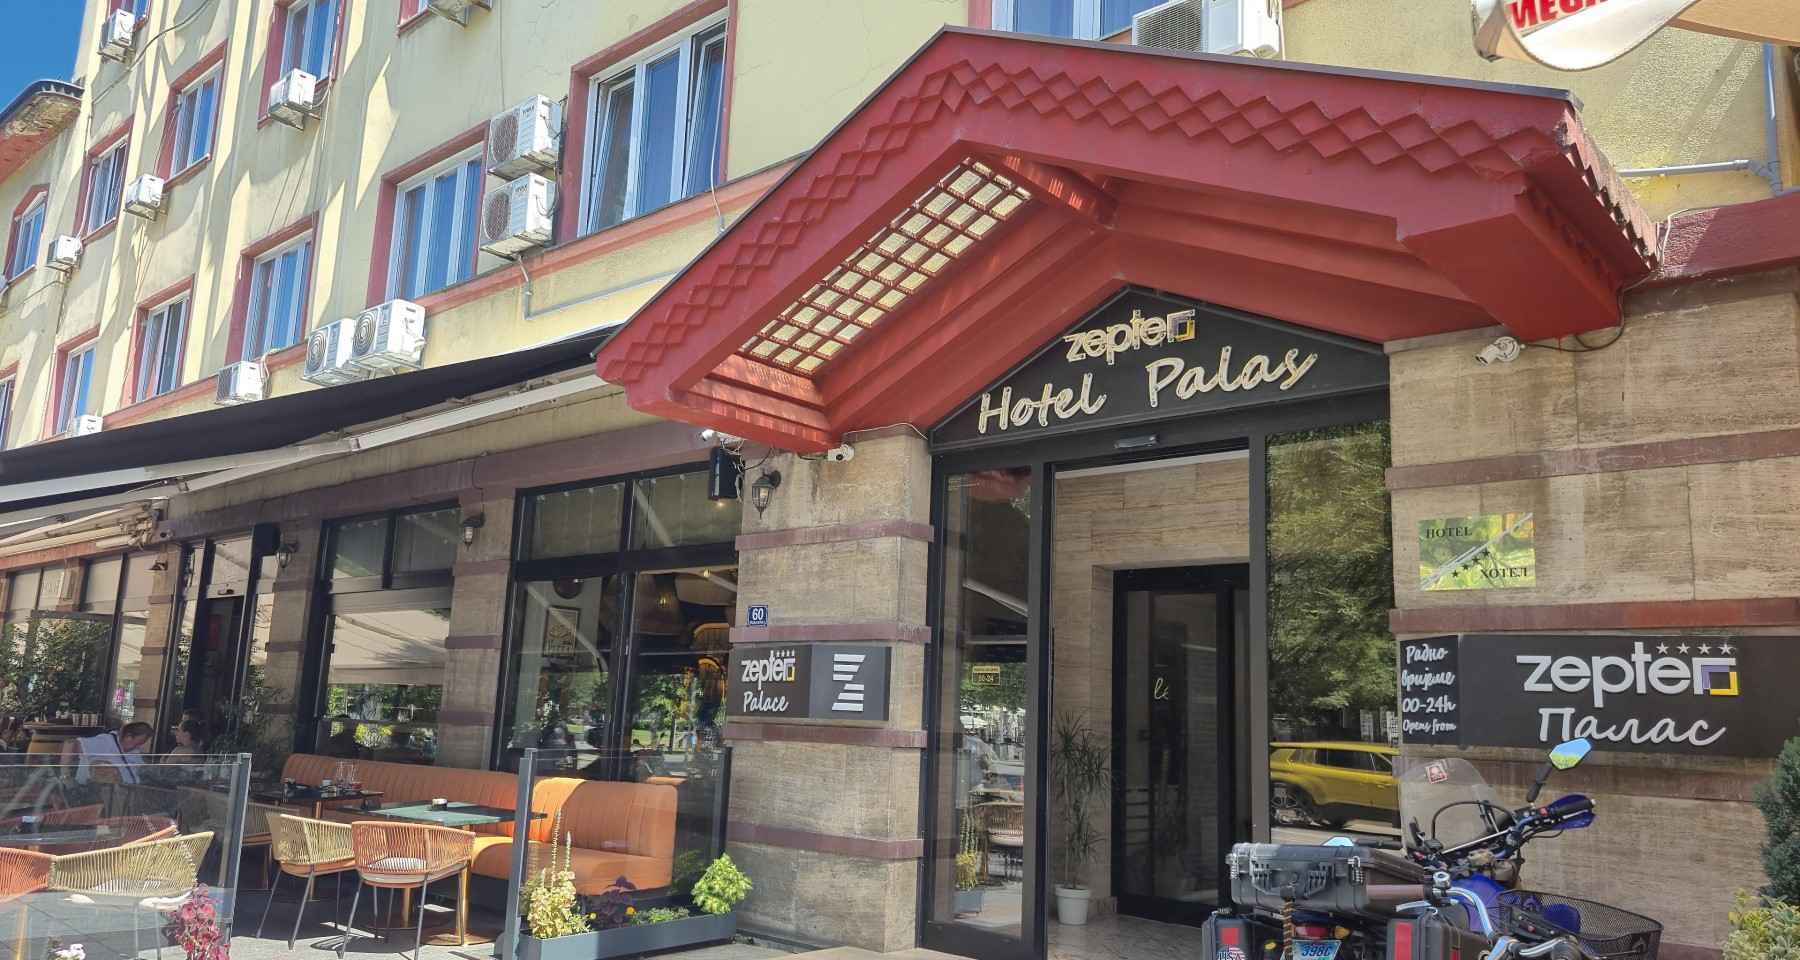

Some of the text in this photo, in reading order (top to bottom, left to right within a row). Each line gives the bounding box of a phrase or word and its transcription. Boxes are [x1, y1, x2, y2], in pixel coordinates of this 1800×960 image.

[1062, 309, 1196, 365] zepter
[978, 346, 1318, 434] Hotel Palas
[1426, 527, 1472, 538] HOTEL
[1480, 567, 1527, 578] ХОТЕЛ
[752, 607, 764, 621] 60
[741, 650, 796, 690] zepter
[1516, 641, 1739, 708] zepter
[743, 690, 789, 712] Palace
[1402, 695, 1457, 713] 00-24h
[1431, 719, 1457, 735] from
[1538, 707, 1726, 746] Палас
